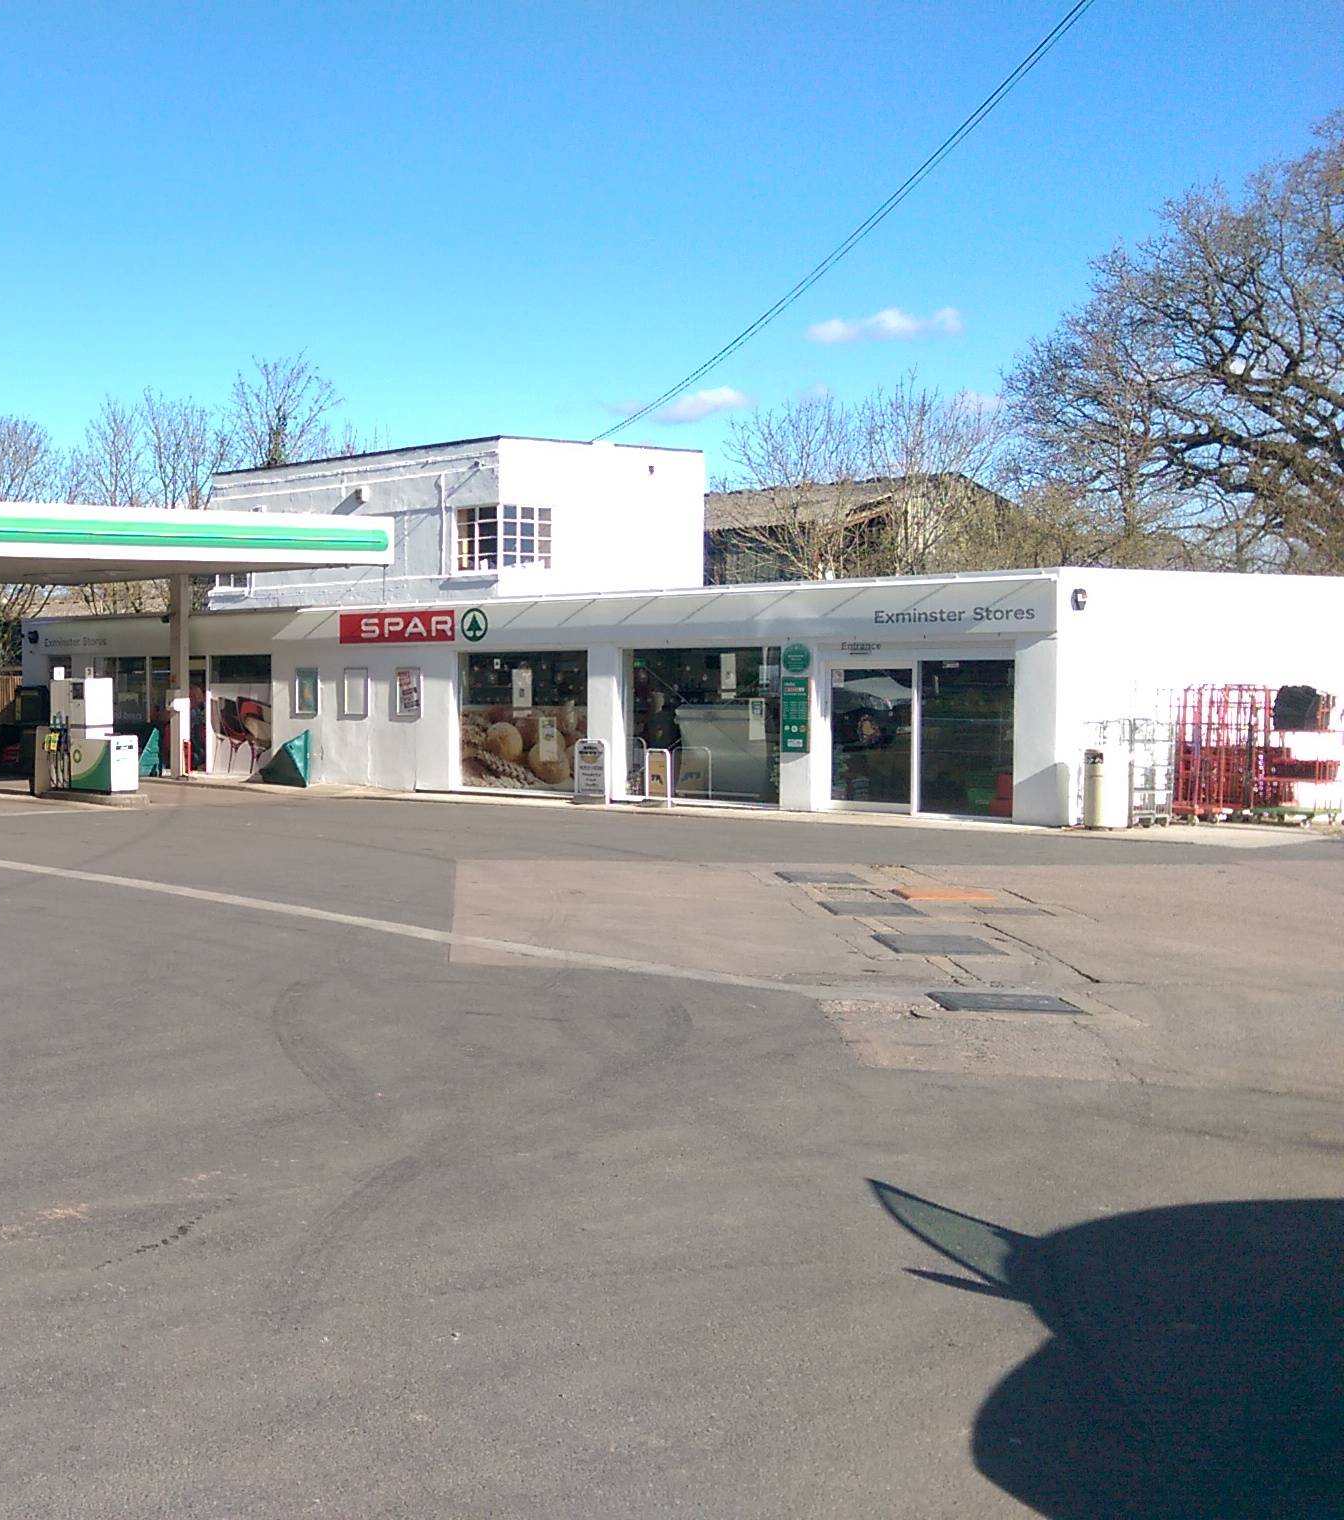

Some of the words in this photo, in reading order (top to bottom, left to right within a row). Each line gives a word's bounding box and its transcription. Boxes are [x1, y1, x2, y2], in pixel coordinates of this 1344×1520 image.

[873, 607, 966, 625] Exminster
[972, 605, 1036, 622] Stores
[360, 615, 453, 639] SPAR
[840, 641, 882, 651] Entrance
